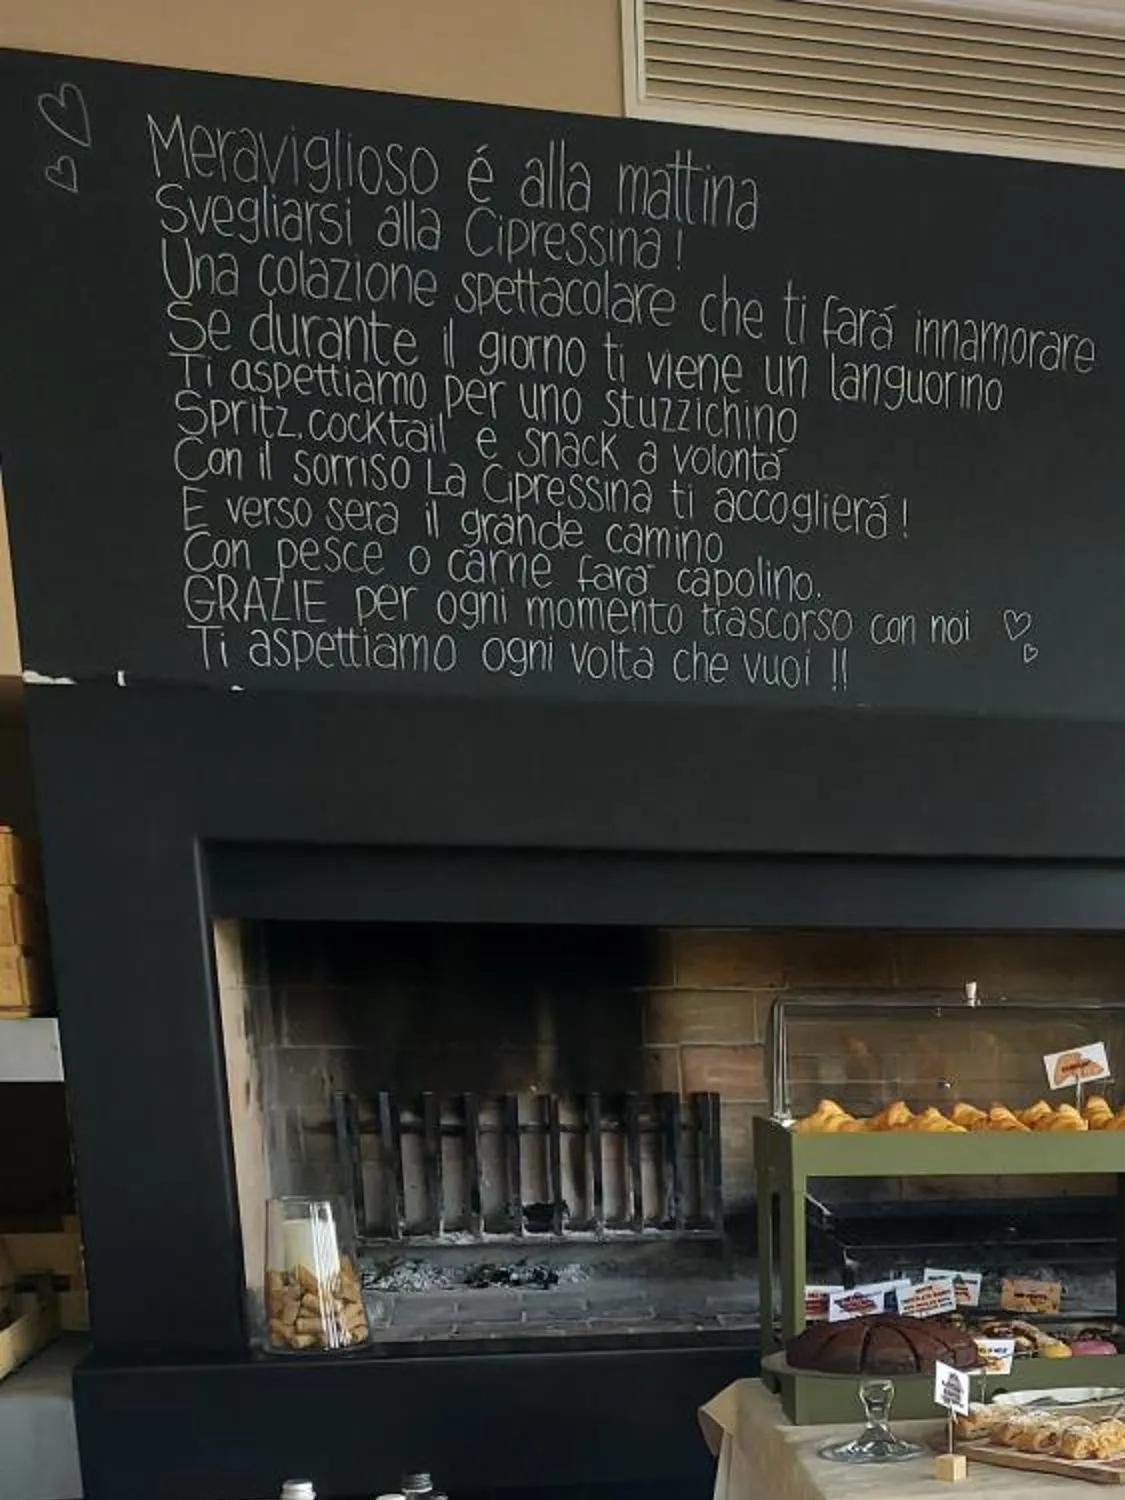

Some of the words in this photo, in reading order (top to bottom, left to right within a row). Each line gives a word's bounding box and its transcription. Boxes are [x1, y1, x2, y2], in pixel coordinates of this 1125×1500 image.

[147, 113, 440, 195] Meraviglioso
[520, 138, 592, 213] alla
[617, 149, 760, 231] mattina
[154, 183, 353, 245] Svegliarsi
[376, 200, 442, 252] alla
[161, 236, 240, 300] Una
[258, 250, 438, 308] colazione
[456, 267, 676, 328] spettacolare
[700, 273, 764, 341] che
[783, 278, 808, 346] ti
[914, 308, 1096, 374] innamorare
[165, 300, 233, 353] Se
[249, 299, 420, 368] durante
[442, 316, 456, 371] il
[479, 329, 587, 379] giorno
[602, 331, 626, 384] ti
[646, 348, 744, 396] viene
[764, 352, 808, 398] un
[830, 352, 1004, 412] languorino
[168, 351, 214, 389] Ti
[229, 357, 428, 410] aspettiamo
[444, 373, 508, 420] per
[518, 382, 583, 426] uno
[602, 386, 798, 444] stuzzichino
[173, 434, 243, 482] Con
[258, 439, 273, 482] il
[292, 448, 412, 491] sorriso
[426, 457, 467, 499] La
[482, 462, 653, 514] Cipressina
[670, 478, 694, 520] ti
[308, 409, 448, 454] cocktail
[476, 426, 498, 461] e
[517, 426, 619, 472] snack
[637, 440, 658, 476] a
[182, 484, 209, 532] E
[225, 494, 313, 530] verso
[325, 496, 400, 536] sera
[424, 499, 440, 541] il
[461, 508, 585, 550] grande
[605, 522, 724, 564] camino
[183, 530, 251, 573] Con
[276, 535, 385, 585] pesce
[408, 544, 432, 576] o
[448, 548, 552, 589] carne
[183, 573, 328, 624] GRAZIE
[354, 583, 419, 627] per
[435, 588, 508, 631] ogni
[526, 596, 684, 638] momento
[699, 601, 854, 642] trascorso
[869, 612, 917, 647] con
[930, 608, 972, 646] noi
[185, 624, 231, 672] Ti
[248, 626, 457, 674] aspettiamo
[481, 635, 554, 678] ogni
[569, 641, 654, 682] volta
[672, 645, 730, 685] che
[741, 647, 812, 690] vuoi
